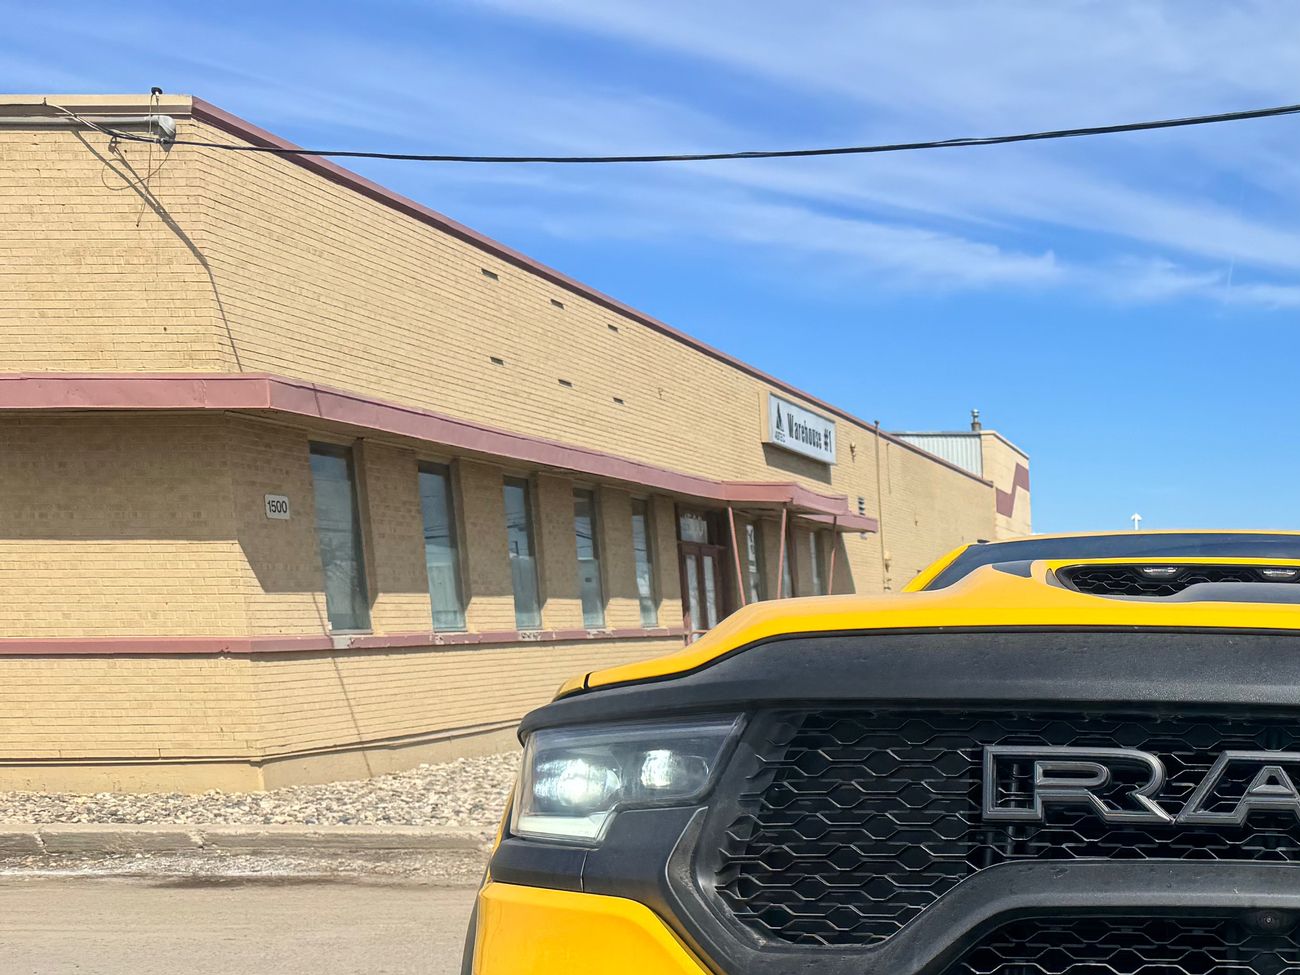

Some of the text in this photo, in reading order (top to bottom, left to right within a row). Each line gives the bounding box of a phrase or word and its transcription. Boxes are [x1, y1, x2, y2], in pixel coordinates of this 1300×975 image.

[787, 412, 822, 450] Warehouse
[824, 428, 833, 454] #1
[267, 500, 288, 513] 1500
